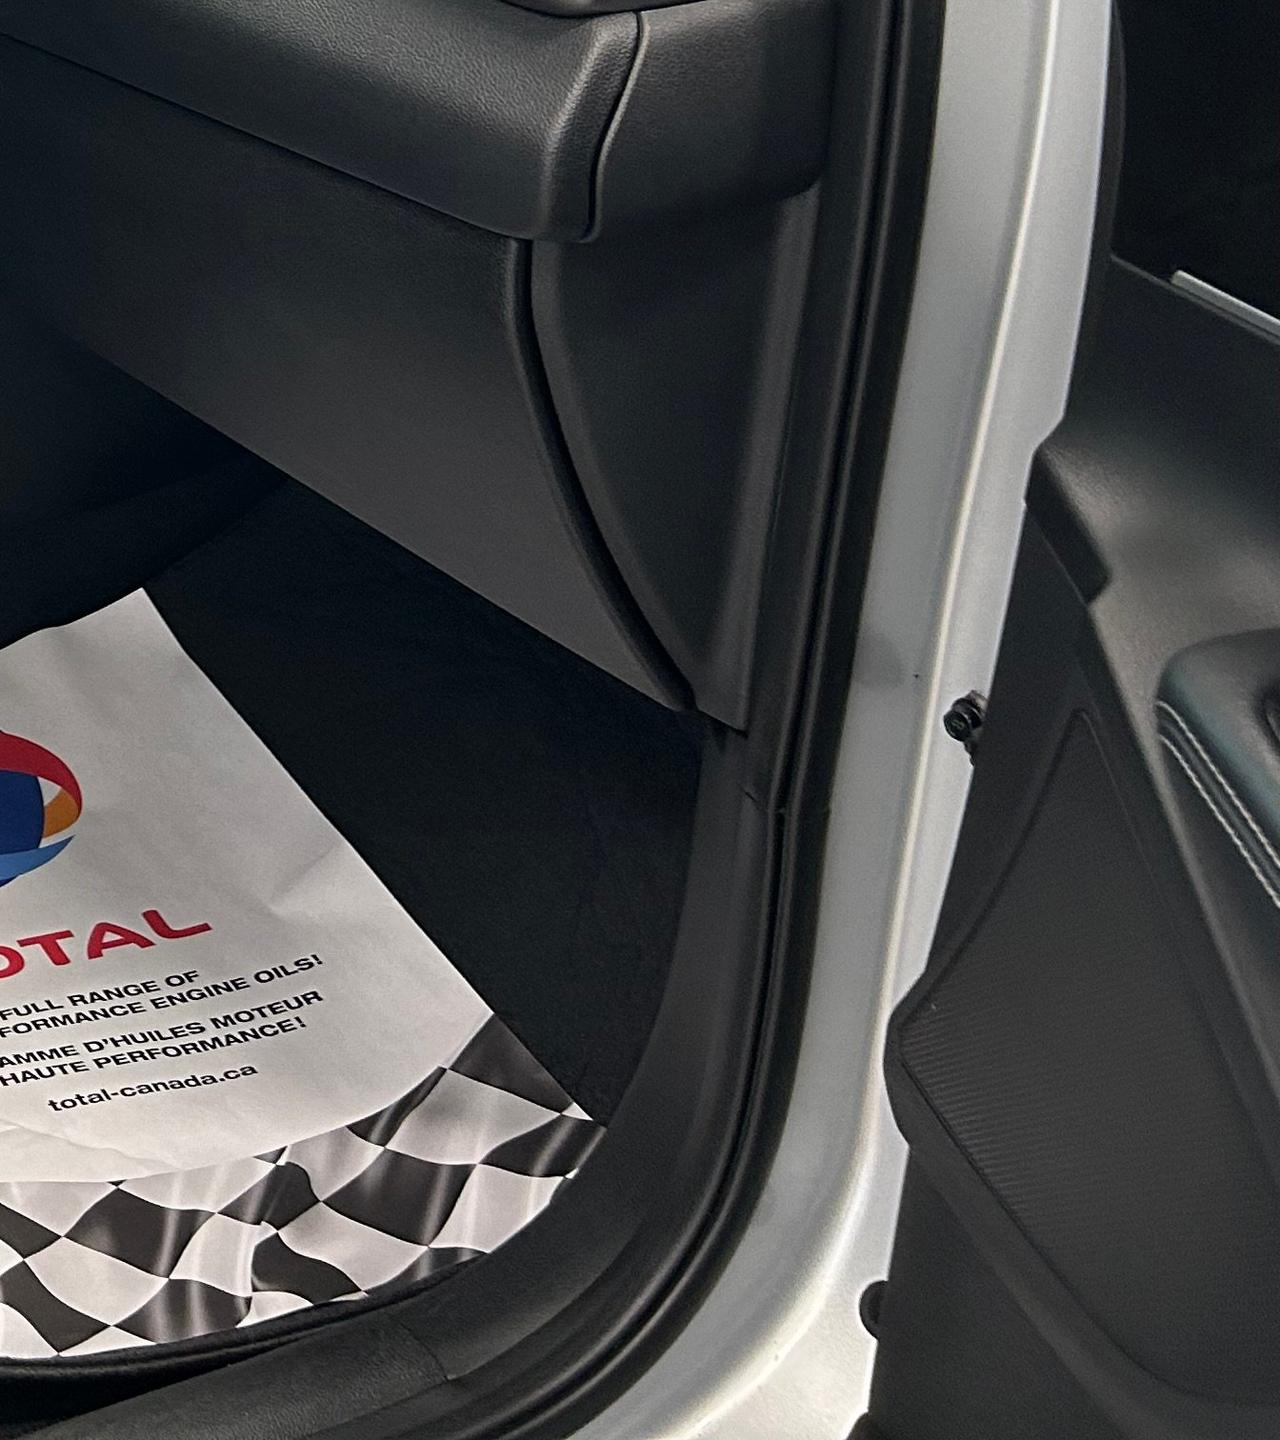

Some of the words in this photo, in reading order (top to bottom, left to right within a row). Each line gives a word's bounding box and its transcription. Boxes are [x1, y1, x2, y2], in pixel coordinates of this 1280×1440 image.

[67, 980, 161, 1007] RANGE
[164, 970, 200, 987] OF
[150, 977, 251, 1010] ENGINE
[253, 954, 323, 984] OILS!
[83, 1022, 206, 1053] D'HUILES
[210, 990, 324, 1030] MOTEUR
[92, 1016, 307, 1070] PERFORMANCE!
[47, 1065, 259, 1112] total-canada.ca
